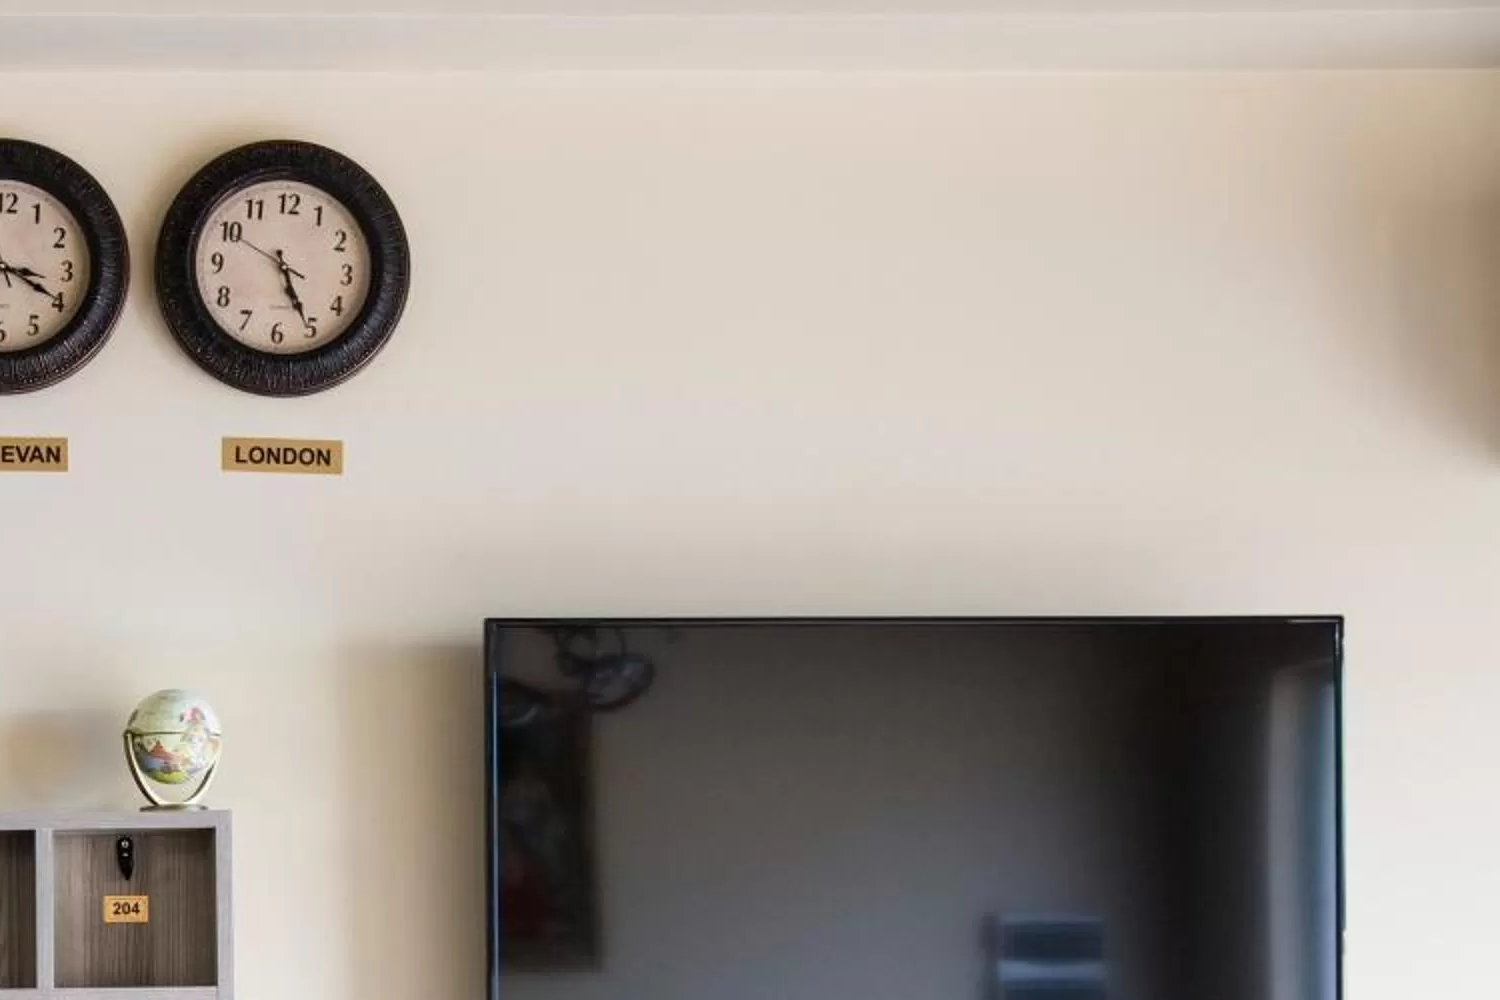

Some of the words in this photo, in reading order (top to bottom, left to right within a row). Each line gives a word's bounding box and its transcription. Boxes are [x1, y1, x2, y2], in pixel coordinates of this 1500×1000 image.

[32, 203, 41, 224] 1
[245, 199, 264, 220] 11
[277, 193, 300, 215] 12
[314, 205, 323, 227] 1
[53, 227, 66, 249] 2
[220, 221, 242, 243] 10
[333, 229, 347, 252] 2
[60, 260, 73, 282] 3
[211, 252, 224, 274] 9
[340, 264, 353, 286] 3
[52, 291, 64, 312] 4
[217, 286, 230, 308] 8
[330, 295, 343, 316] 4
[26, 314, 40, 336] 5
[240, 309, 253, 331] 7
[304, 318, 317, 338] 5
[271, 322, 284, 344] 6
[234, 446, 332, 466] LONDON
[112, 901, 141, 916] 204
